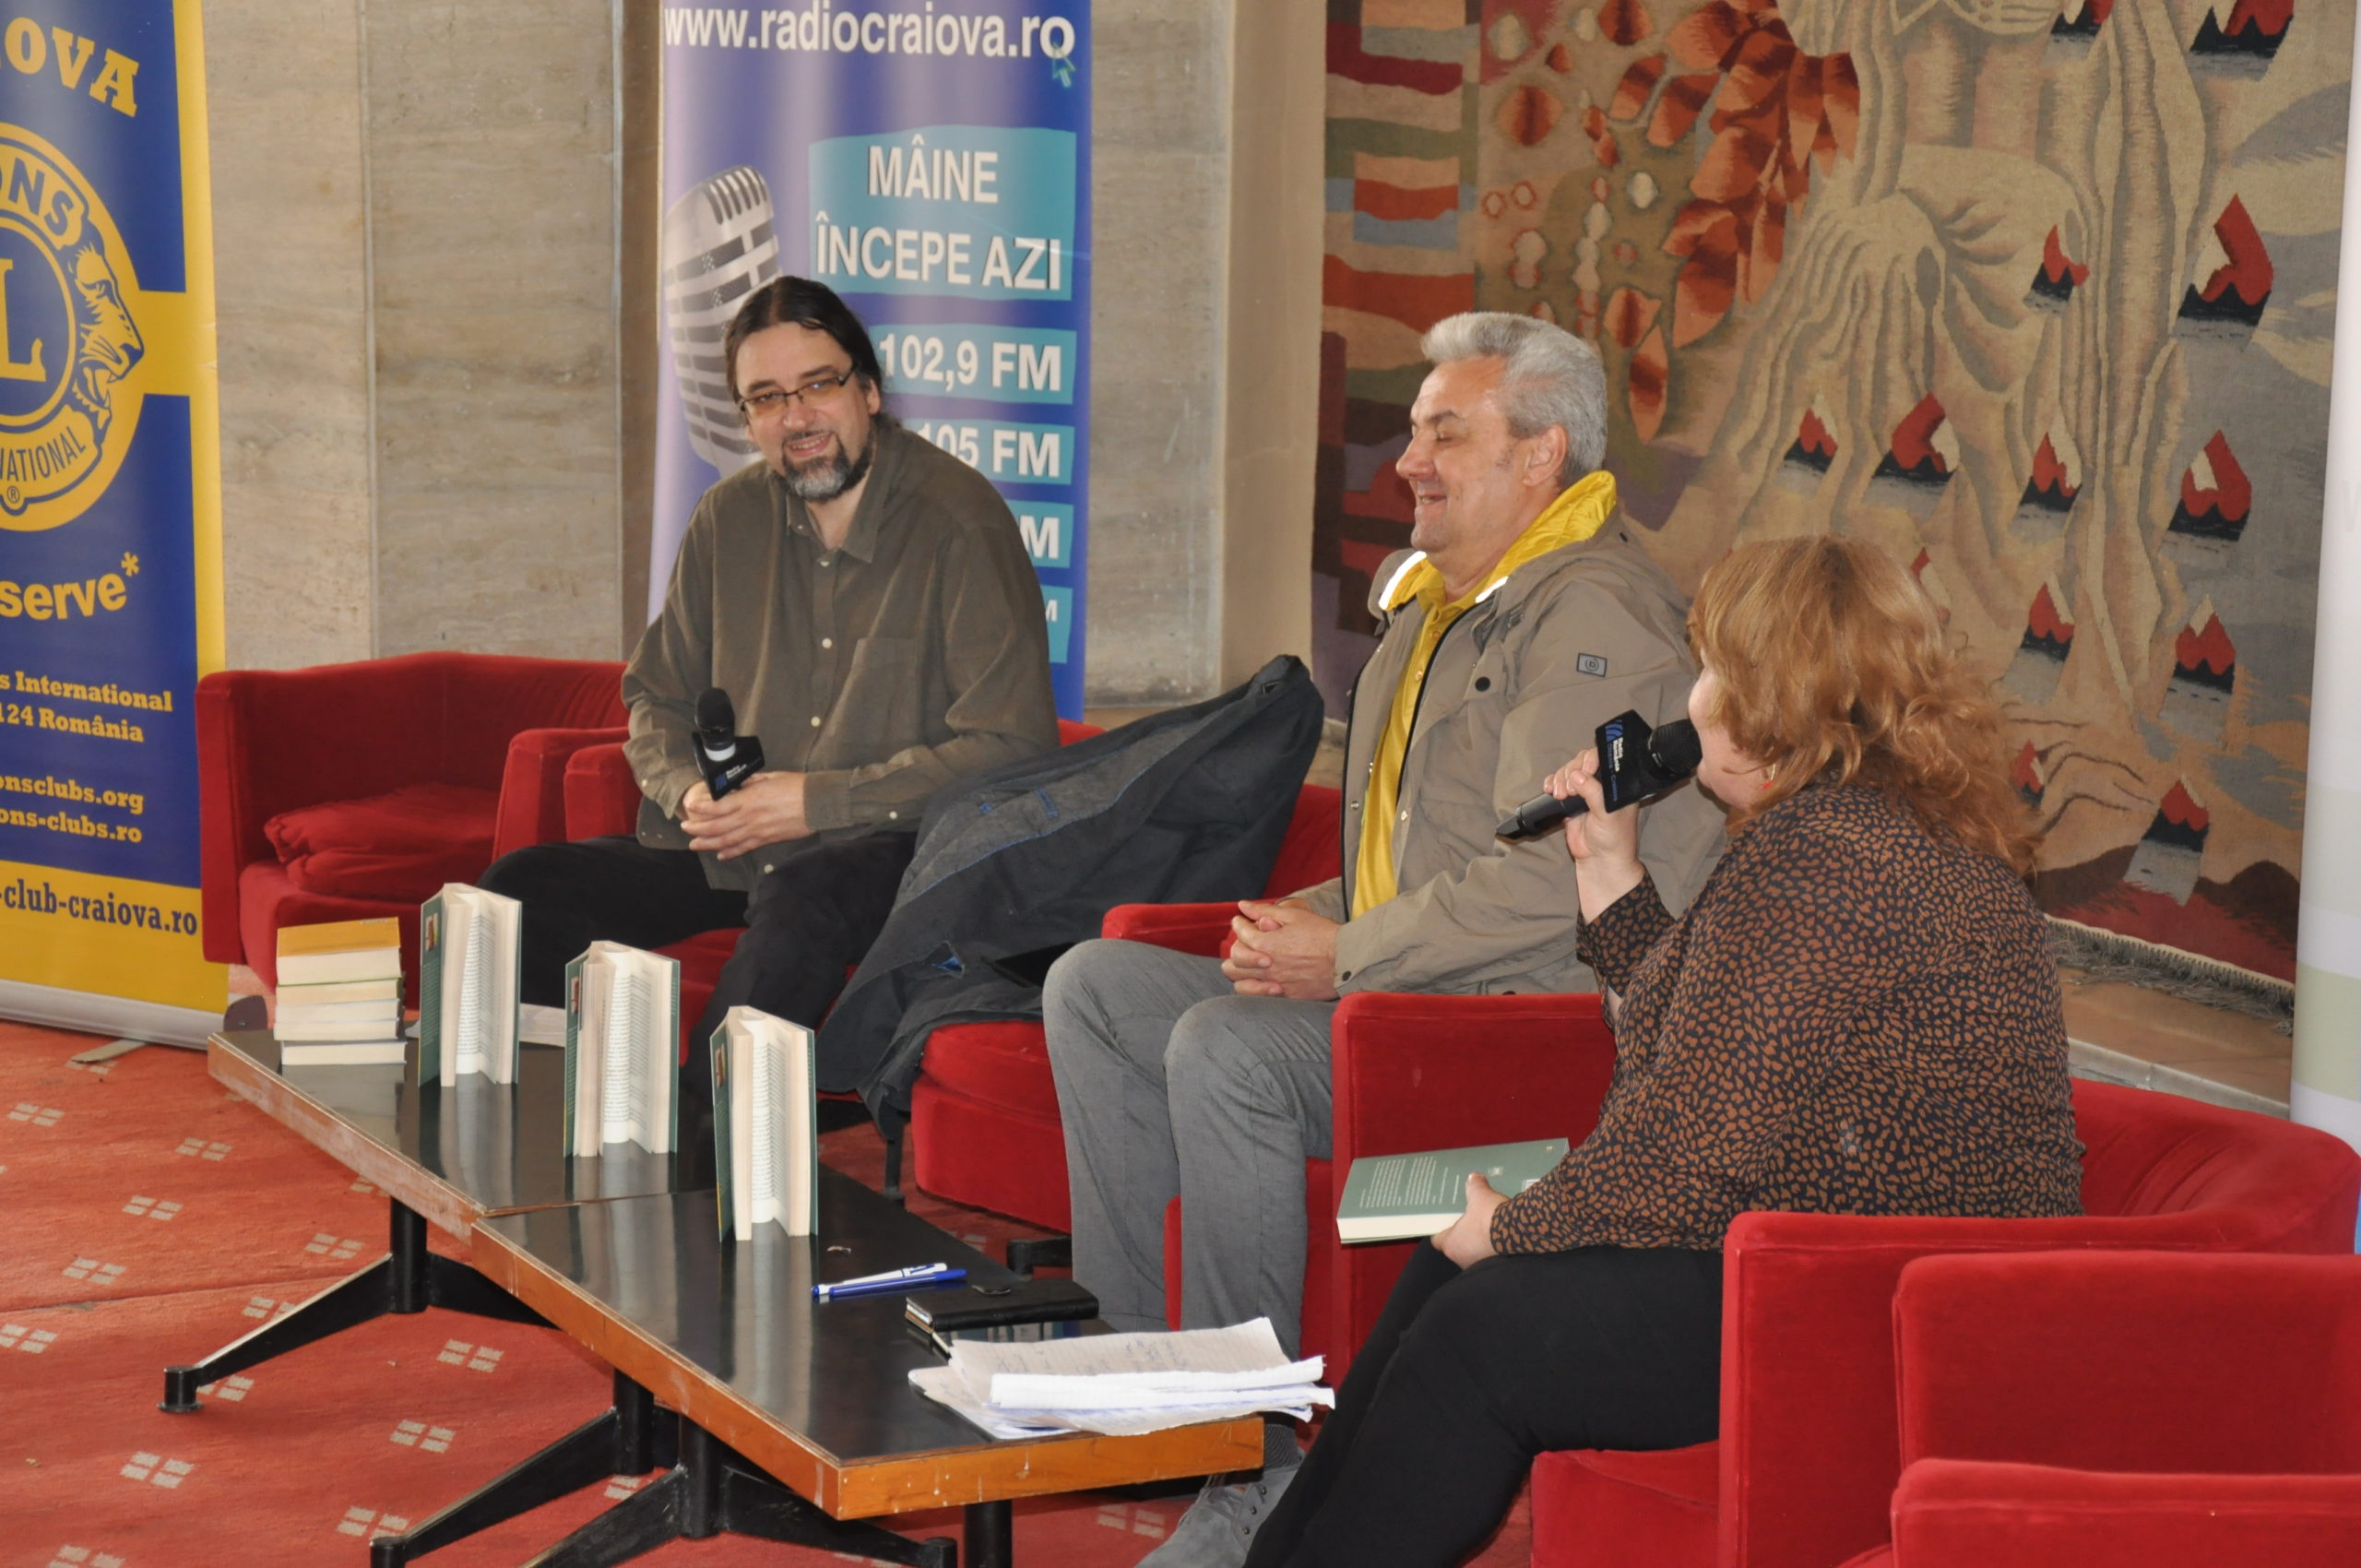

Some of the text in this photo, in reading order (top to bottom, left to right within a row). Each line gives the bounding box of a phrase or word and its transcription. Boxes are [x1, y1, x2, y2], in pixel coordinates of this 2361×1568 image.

[663, 0, 1074, 58] www.radiocraiova.ro
[0, 17, 139, 117] OVA
[0, 157, 75, 236] NS
[868, 134, 999, 204] MÂINE
[815, 211, 1062, 291] ÎNCEPE AZI
[878, 333, 1062, 393] 102,9 FM
[992, 428, 1060, 478] FM
[16, 671, 173, 712] International
[39, 707, 144, 742] România
[0, 878, 198, 935] club-craiova.ro
